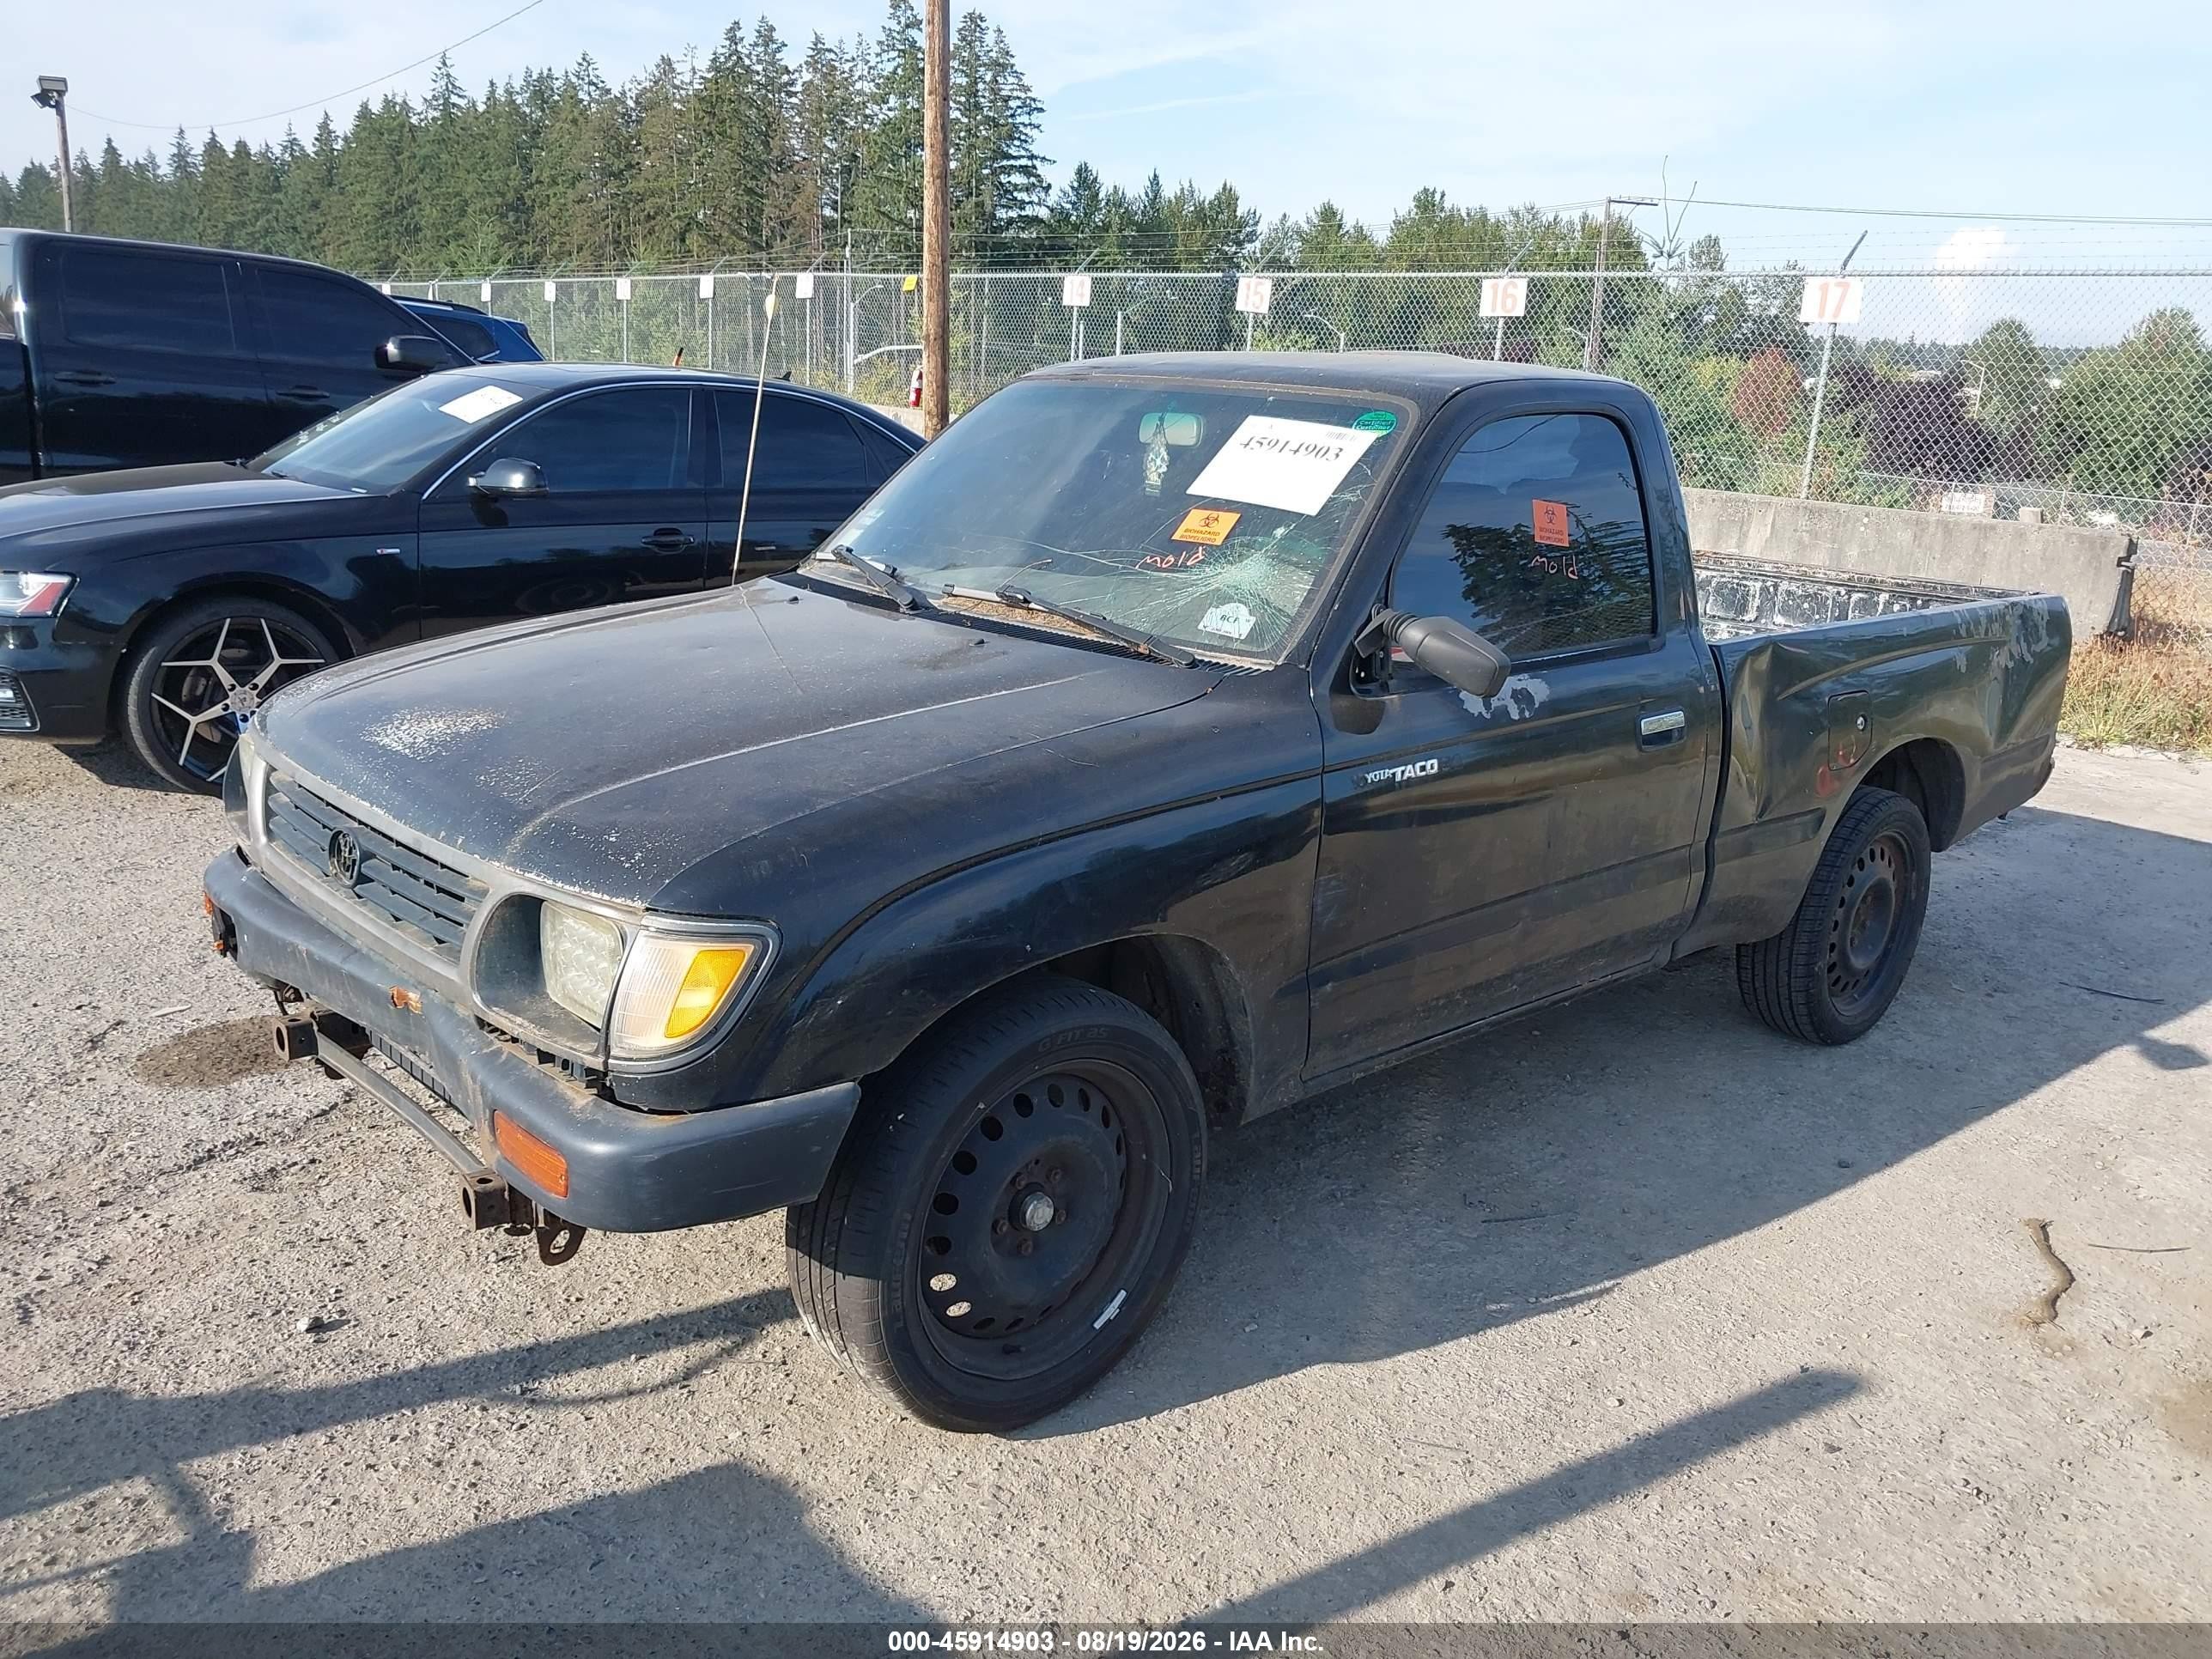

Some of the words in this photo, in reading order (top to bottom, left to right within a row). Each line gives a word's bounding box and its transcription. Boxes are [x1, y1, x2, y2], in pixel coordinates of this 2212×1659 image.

[1069, 276, 1085, 304] 14
[1246, 276, 1265, 310] 15
[1490, 280, 1518, 314] 16
[1816, 281, 1850, 319] 17
[1240, 435, 1344, 461] 45914903
[1179, 534, 1217, 544] BIOPELIGRO
[1183, 527, 1221, 537] BIOHAZARD
[1391, 758, 1438, 782] TACO
